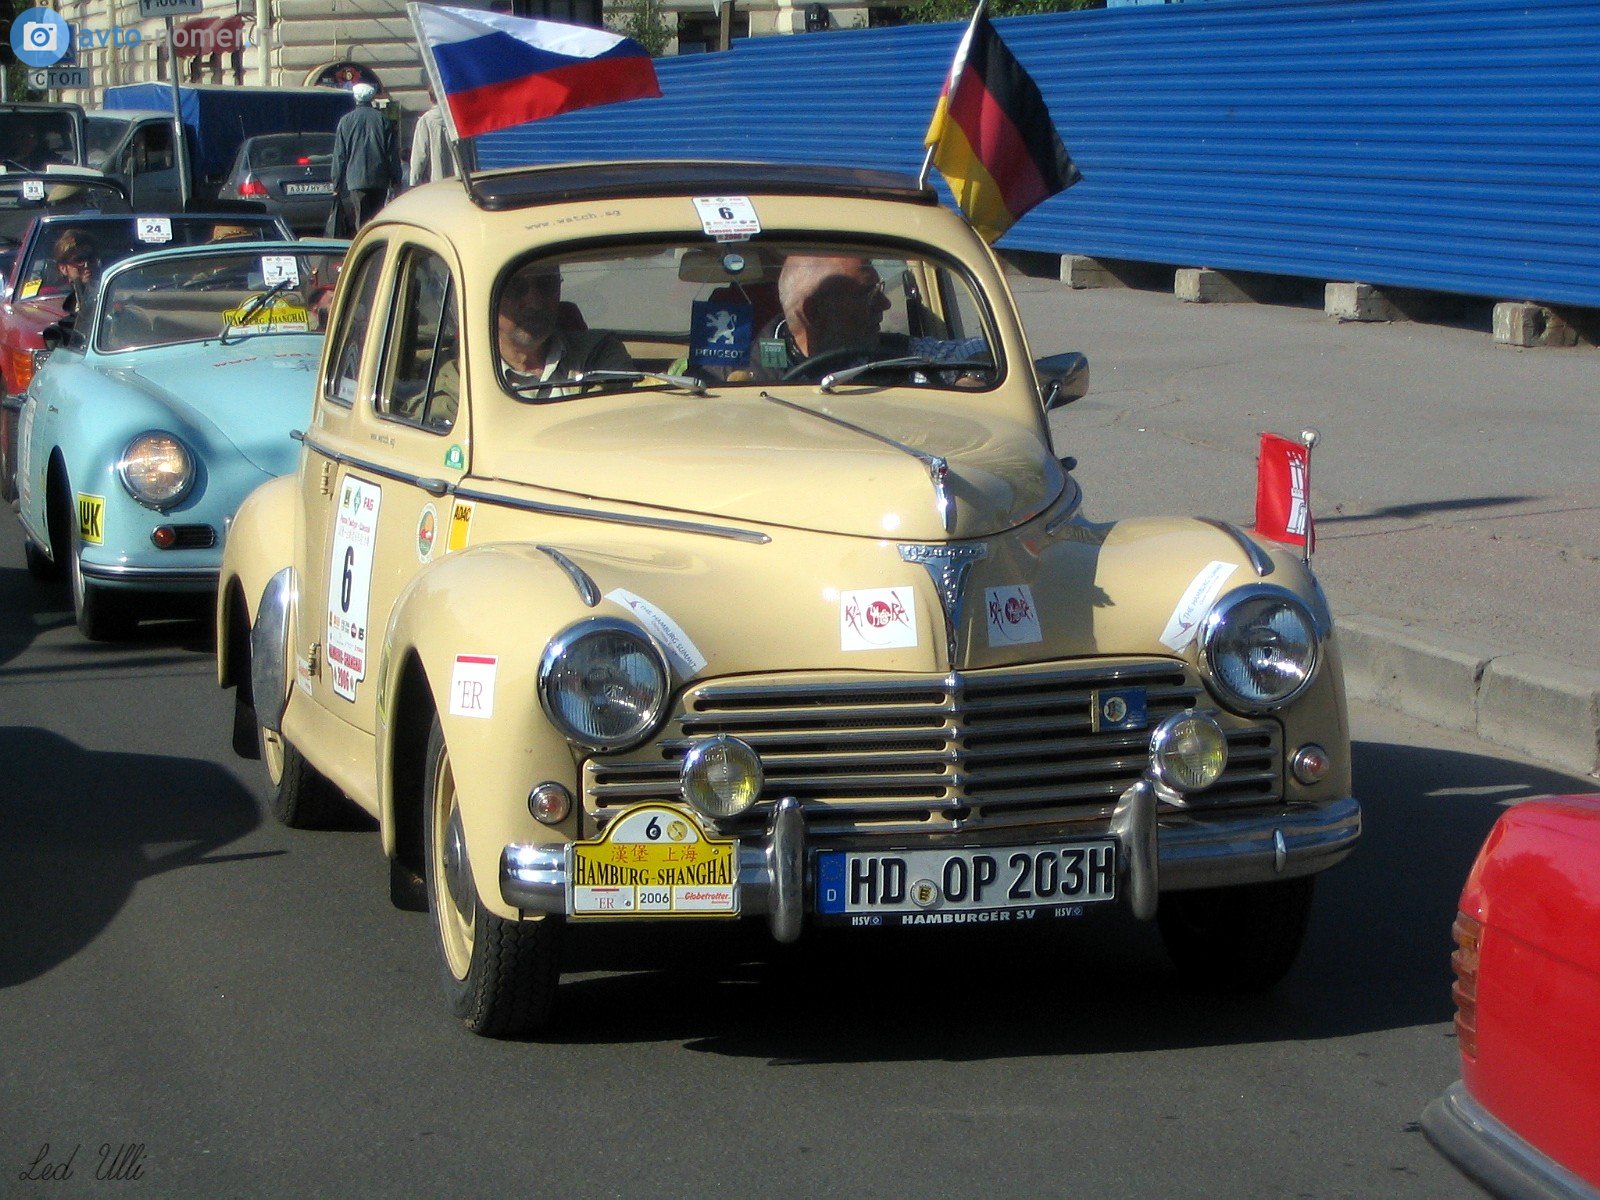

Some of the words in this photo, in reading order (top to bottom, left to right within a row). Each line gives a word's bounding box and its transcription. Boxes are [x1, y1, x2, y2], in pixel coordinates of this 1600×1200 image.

[35, 72, 82, 87] СТОП
[718, 206, 735, 220] 6
[146, 224, 162, 234] 24
[275, 265, 283, 276] 7
[694, 348, 745, 359] PEUGEOT
[453, 505, 472, 522] ADAC
[341, 545, 355, 613] 6
[652, 614, 680, 643] HAMBURG
[676, 643, 696, 668] SUMMIT
[645, 816, 662, 841] 6
[850, 857, 906, 905] HD
[943, 855, 997, 903] OP
[1007, 846, 1114, 900] 203H
[640, 892, 670, 904] 2006
[684, 891, 730, 901] Globetrotter
[826, 888, 837, 902] D
[901, 910, 1011, 925] HAMBURGER
[1016, 909, 1036, 920] SV
[1055, 907, 1072, 917] HSV
[852, 916, 870, 926] HSV
